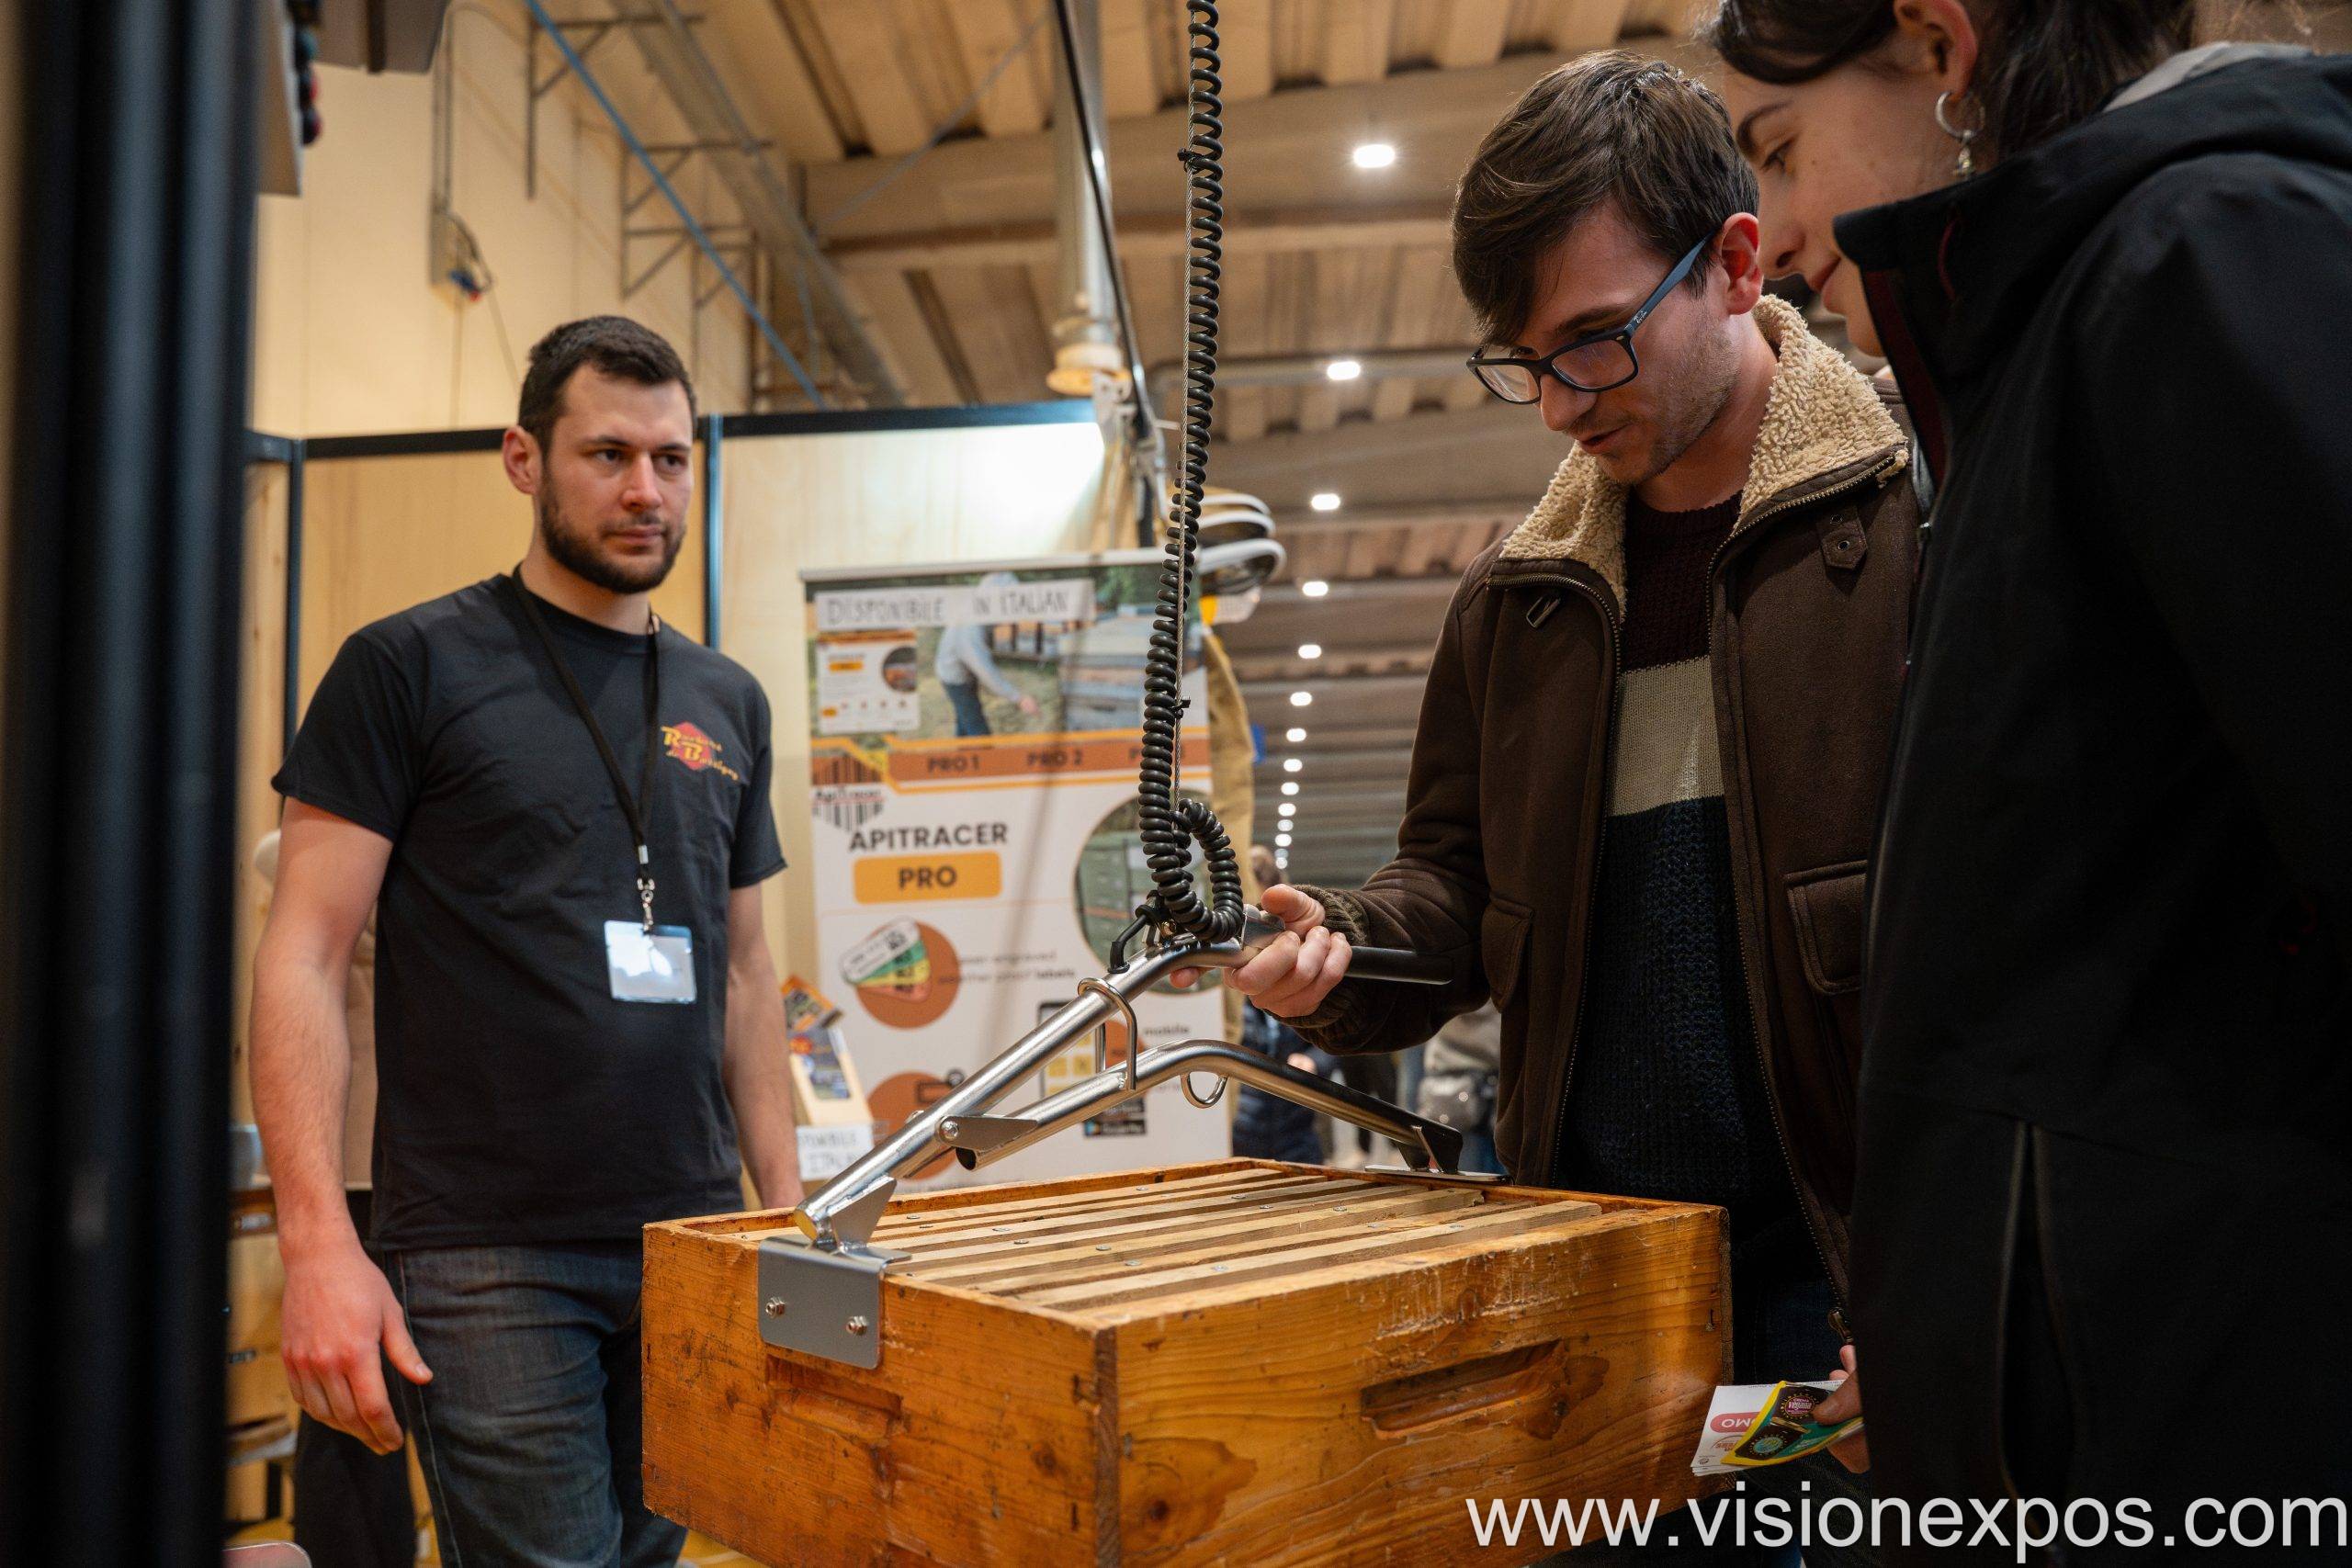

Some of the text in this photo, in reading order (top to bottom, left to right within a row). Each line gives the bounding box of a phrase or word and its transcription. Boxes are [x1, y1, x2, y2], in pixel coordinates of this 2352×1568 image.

[928, 756, 968, 773] PRO
[1071, 750, 1083, 767] 2
[849, 822, 1009, 854] APITRACER
[898, 865, 958, 891] PRO
